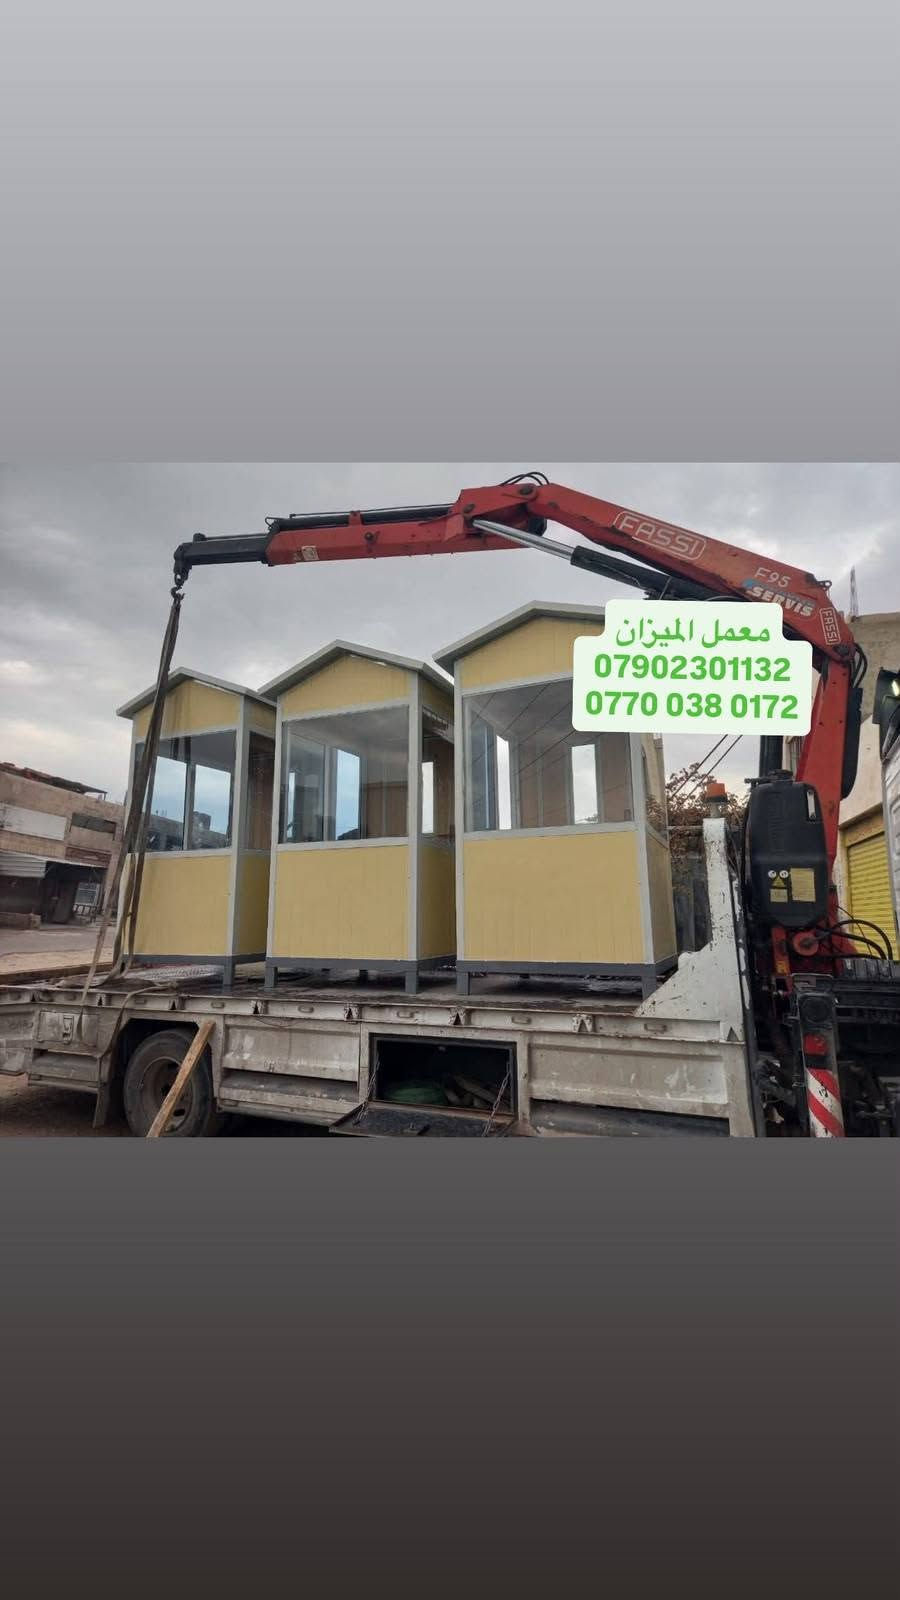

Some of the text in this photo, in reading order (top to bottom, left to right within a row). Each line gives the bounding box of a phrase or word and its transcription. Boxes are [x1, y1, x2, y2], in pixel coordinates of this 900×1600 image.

[619, 515, 699, 555] FASSI
[755, 567, 791, 588] F95
[750, 586, 813, 617] SERVIS
[822, 609, 838, 643] FASSI
